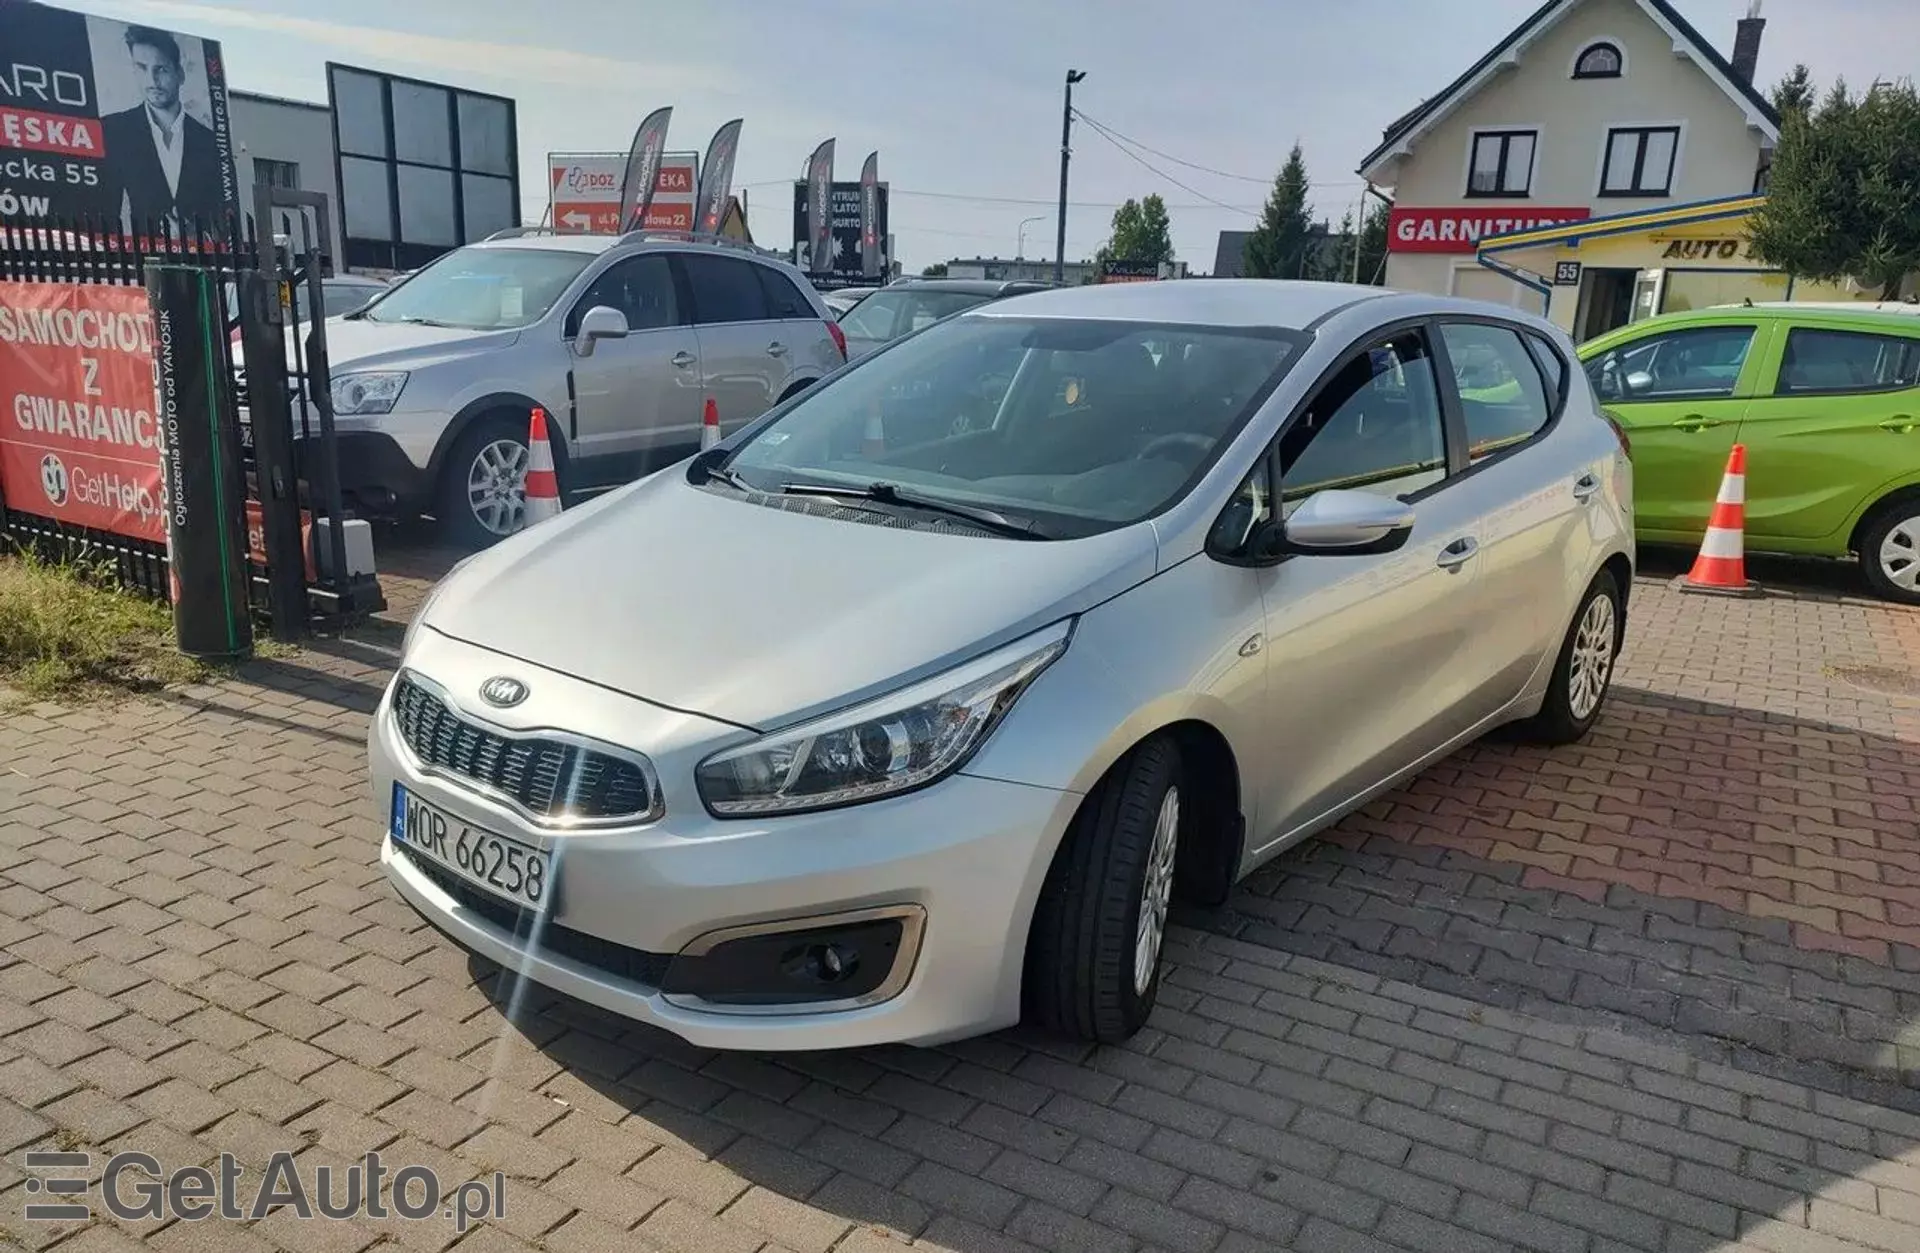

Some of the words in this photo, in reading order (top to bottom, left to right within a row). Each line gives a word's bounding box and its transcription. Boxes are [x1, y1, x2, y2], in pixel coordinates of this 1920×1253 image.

[2, 113, 94, 148] ĘSKA
[210, 84, 233, 201] www.villaro.pl
[0, 158, 56, 182] cka
[65, 163, 98, 185] 55
[659, 174, 687, 189] EKA
[673, 212, 686, 226] 22
[1397, 218, 1577, 242] GARNITU
[1662, 239, 1738, 259] AUTO
[1557, 264, 1577, 279] 55
[160, 309, 174, 375] YANOSIK
[80, 357, 102, 396] Z
[164, 377, 176, 397] od
[166, 400, 180, 446] MOTO
[406, 795, 448, 861] WOR
[456, 827, 543, 902] 66258
